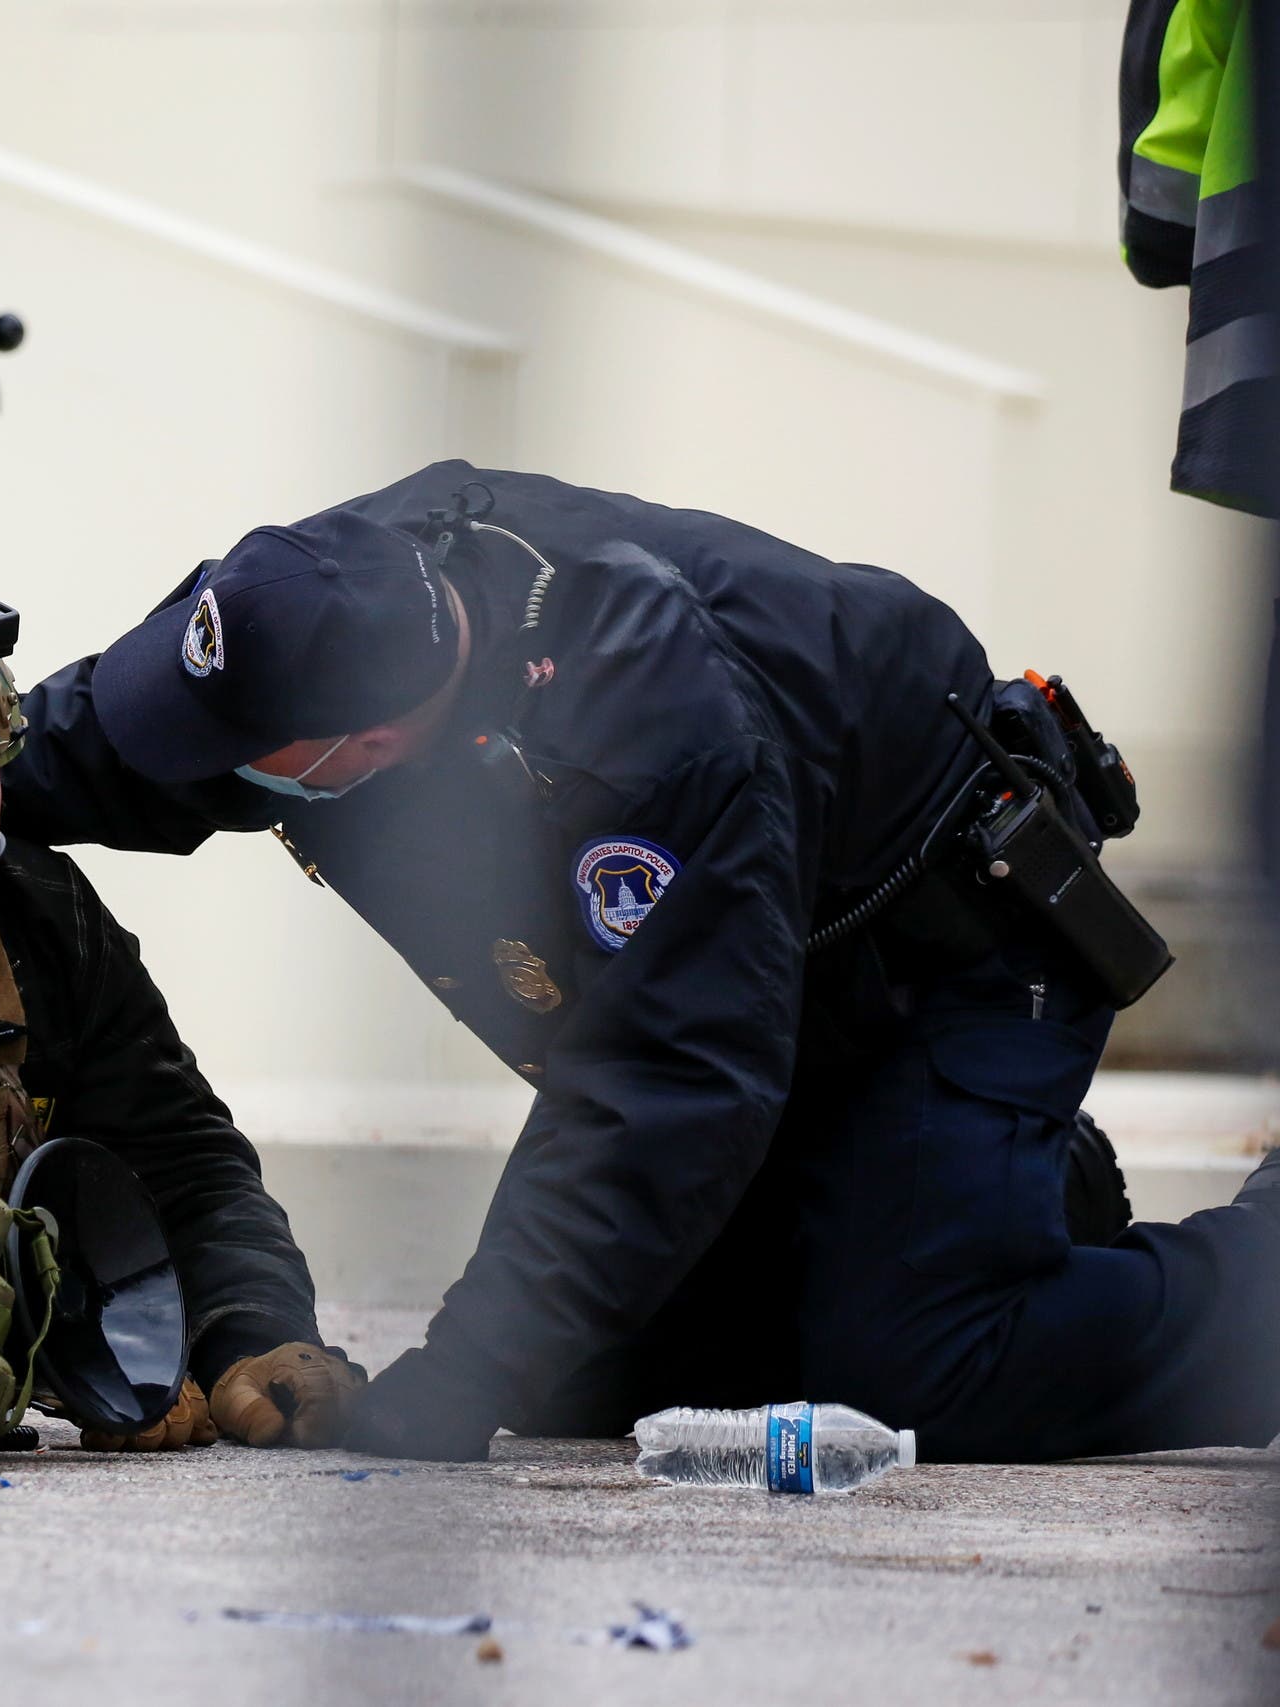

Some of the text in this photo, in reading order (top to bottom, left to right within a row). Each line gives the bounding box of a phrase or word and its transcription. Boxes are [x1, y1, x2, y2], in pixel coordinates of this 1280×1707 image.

[578, 845, 672, 884] UNITED STATES CAPITOL POLICE
[622, 920, 641, 931] 182
[787, 1434, 796, 1475] PURIFIED
